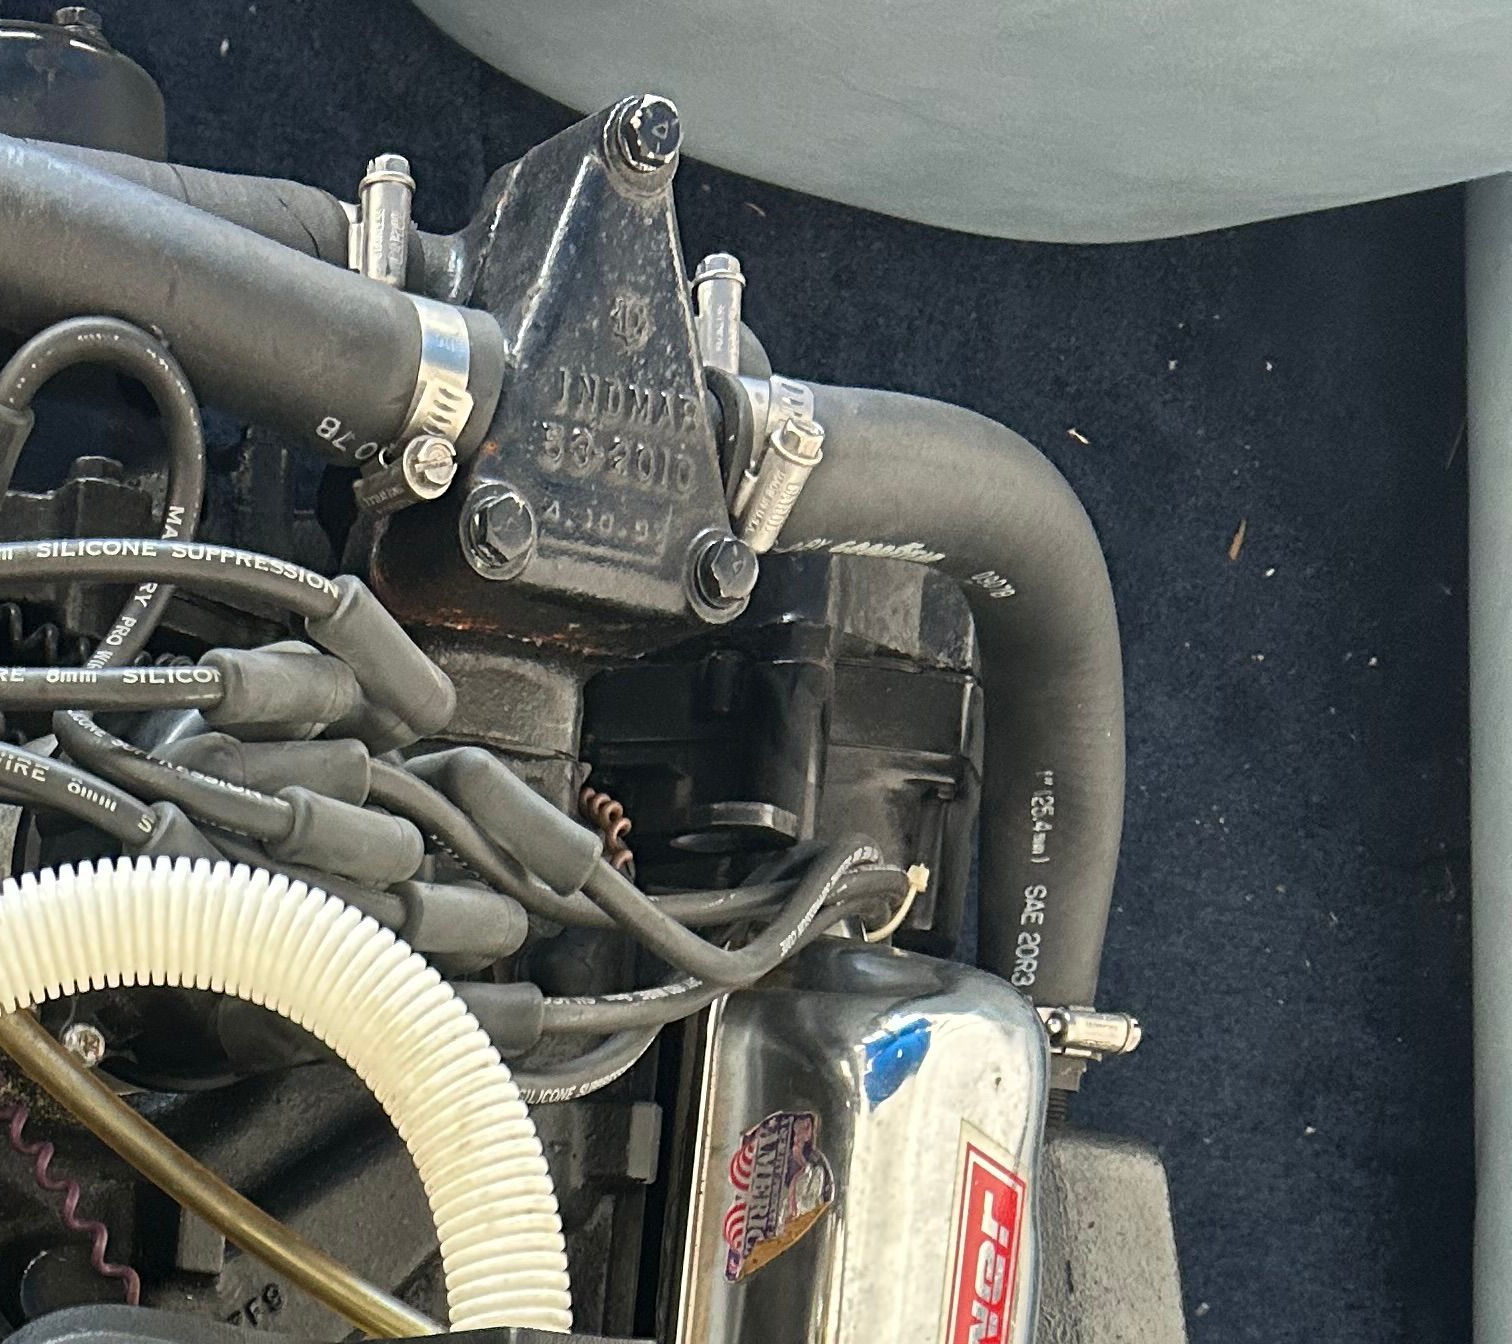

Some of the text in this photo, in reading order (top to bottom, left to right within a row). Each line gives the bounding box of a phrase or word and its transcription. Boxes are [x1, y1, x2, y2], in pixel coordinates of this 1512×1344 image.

[559, 366, 699, 429] INDMAR
[36, 539, 158, 559] SILICONE
[172, 542, 339, 599] SUPPRESSION
[105, 616, 138, 647] PRO
[45, 669, 97, 683] 8mm
[1020, 884, 1048, 925] SAE
[1011, 932, 1041, 986] 20R3
